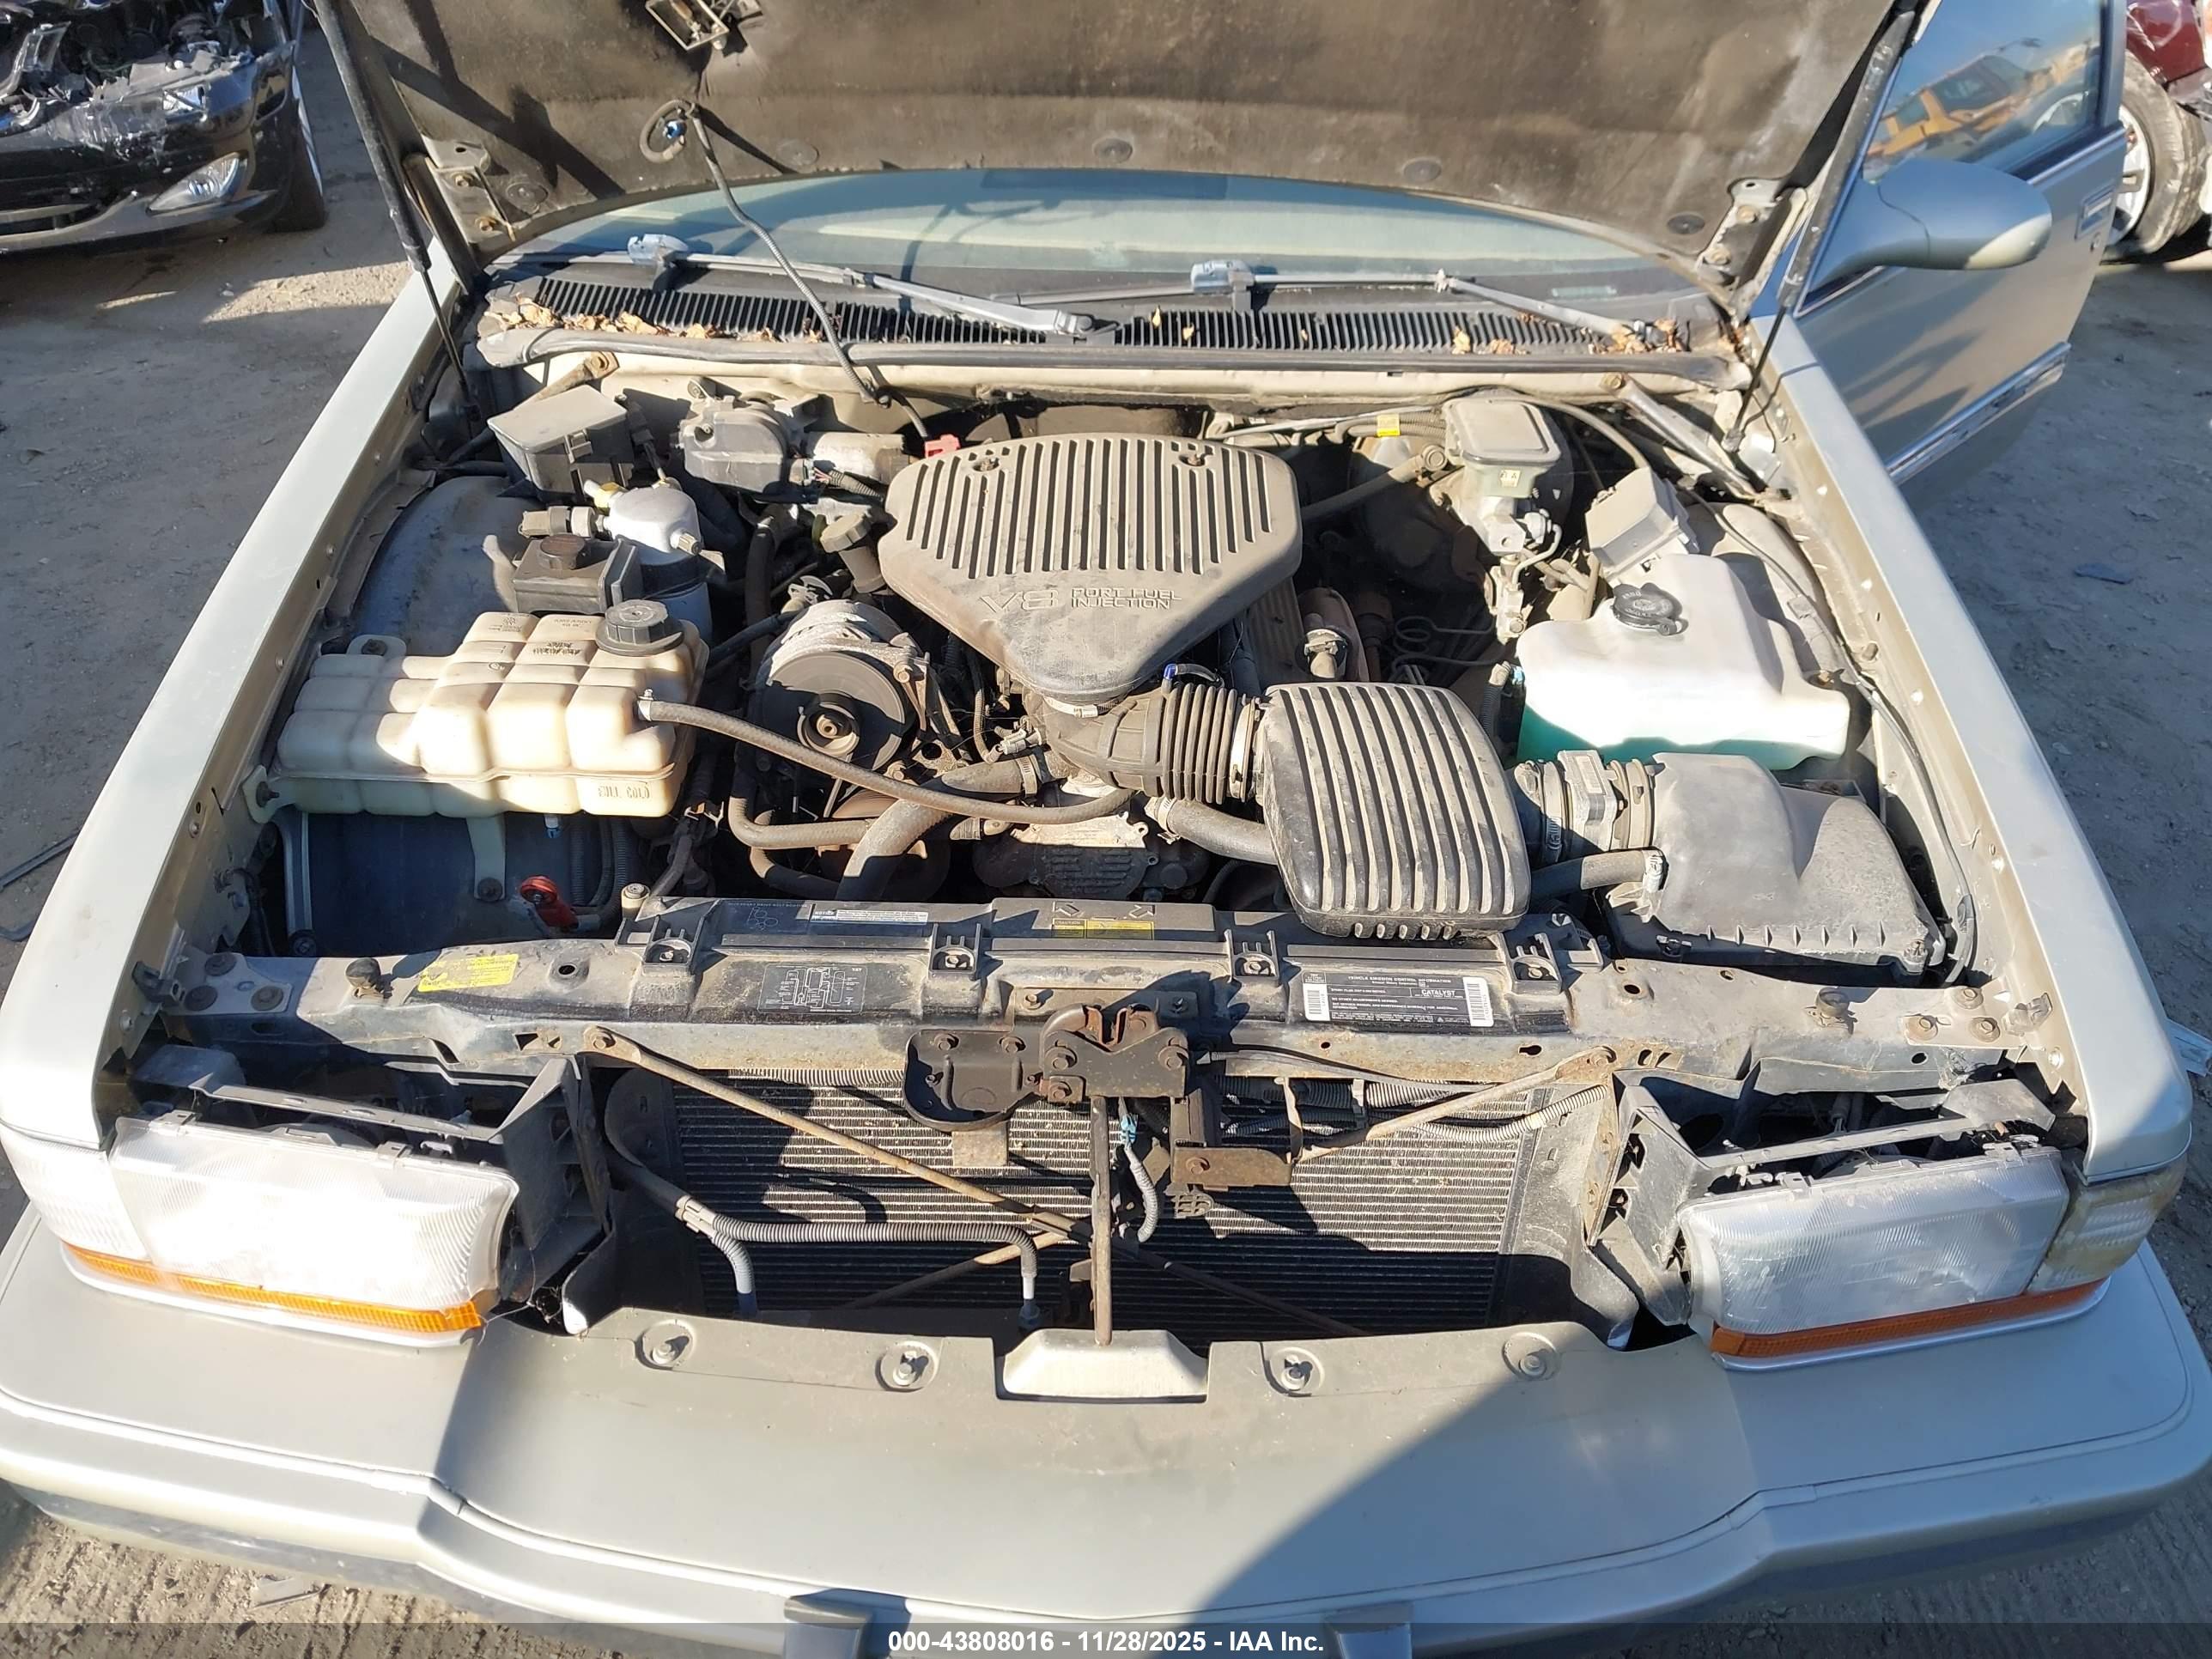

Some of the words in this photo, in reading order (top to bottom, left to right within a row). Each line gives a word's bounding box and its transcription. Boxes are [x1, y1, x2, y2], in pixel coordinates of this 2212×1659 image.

[980, 589, 1059, 613] V8
[1072, 587, 1127, 599] PORT
[1132, 589, 1182, 601] FUEL
[1072, 597, 1170, 611] INJECTION
